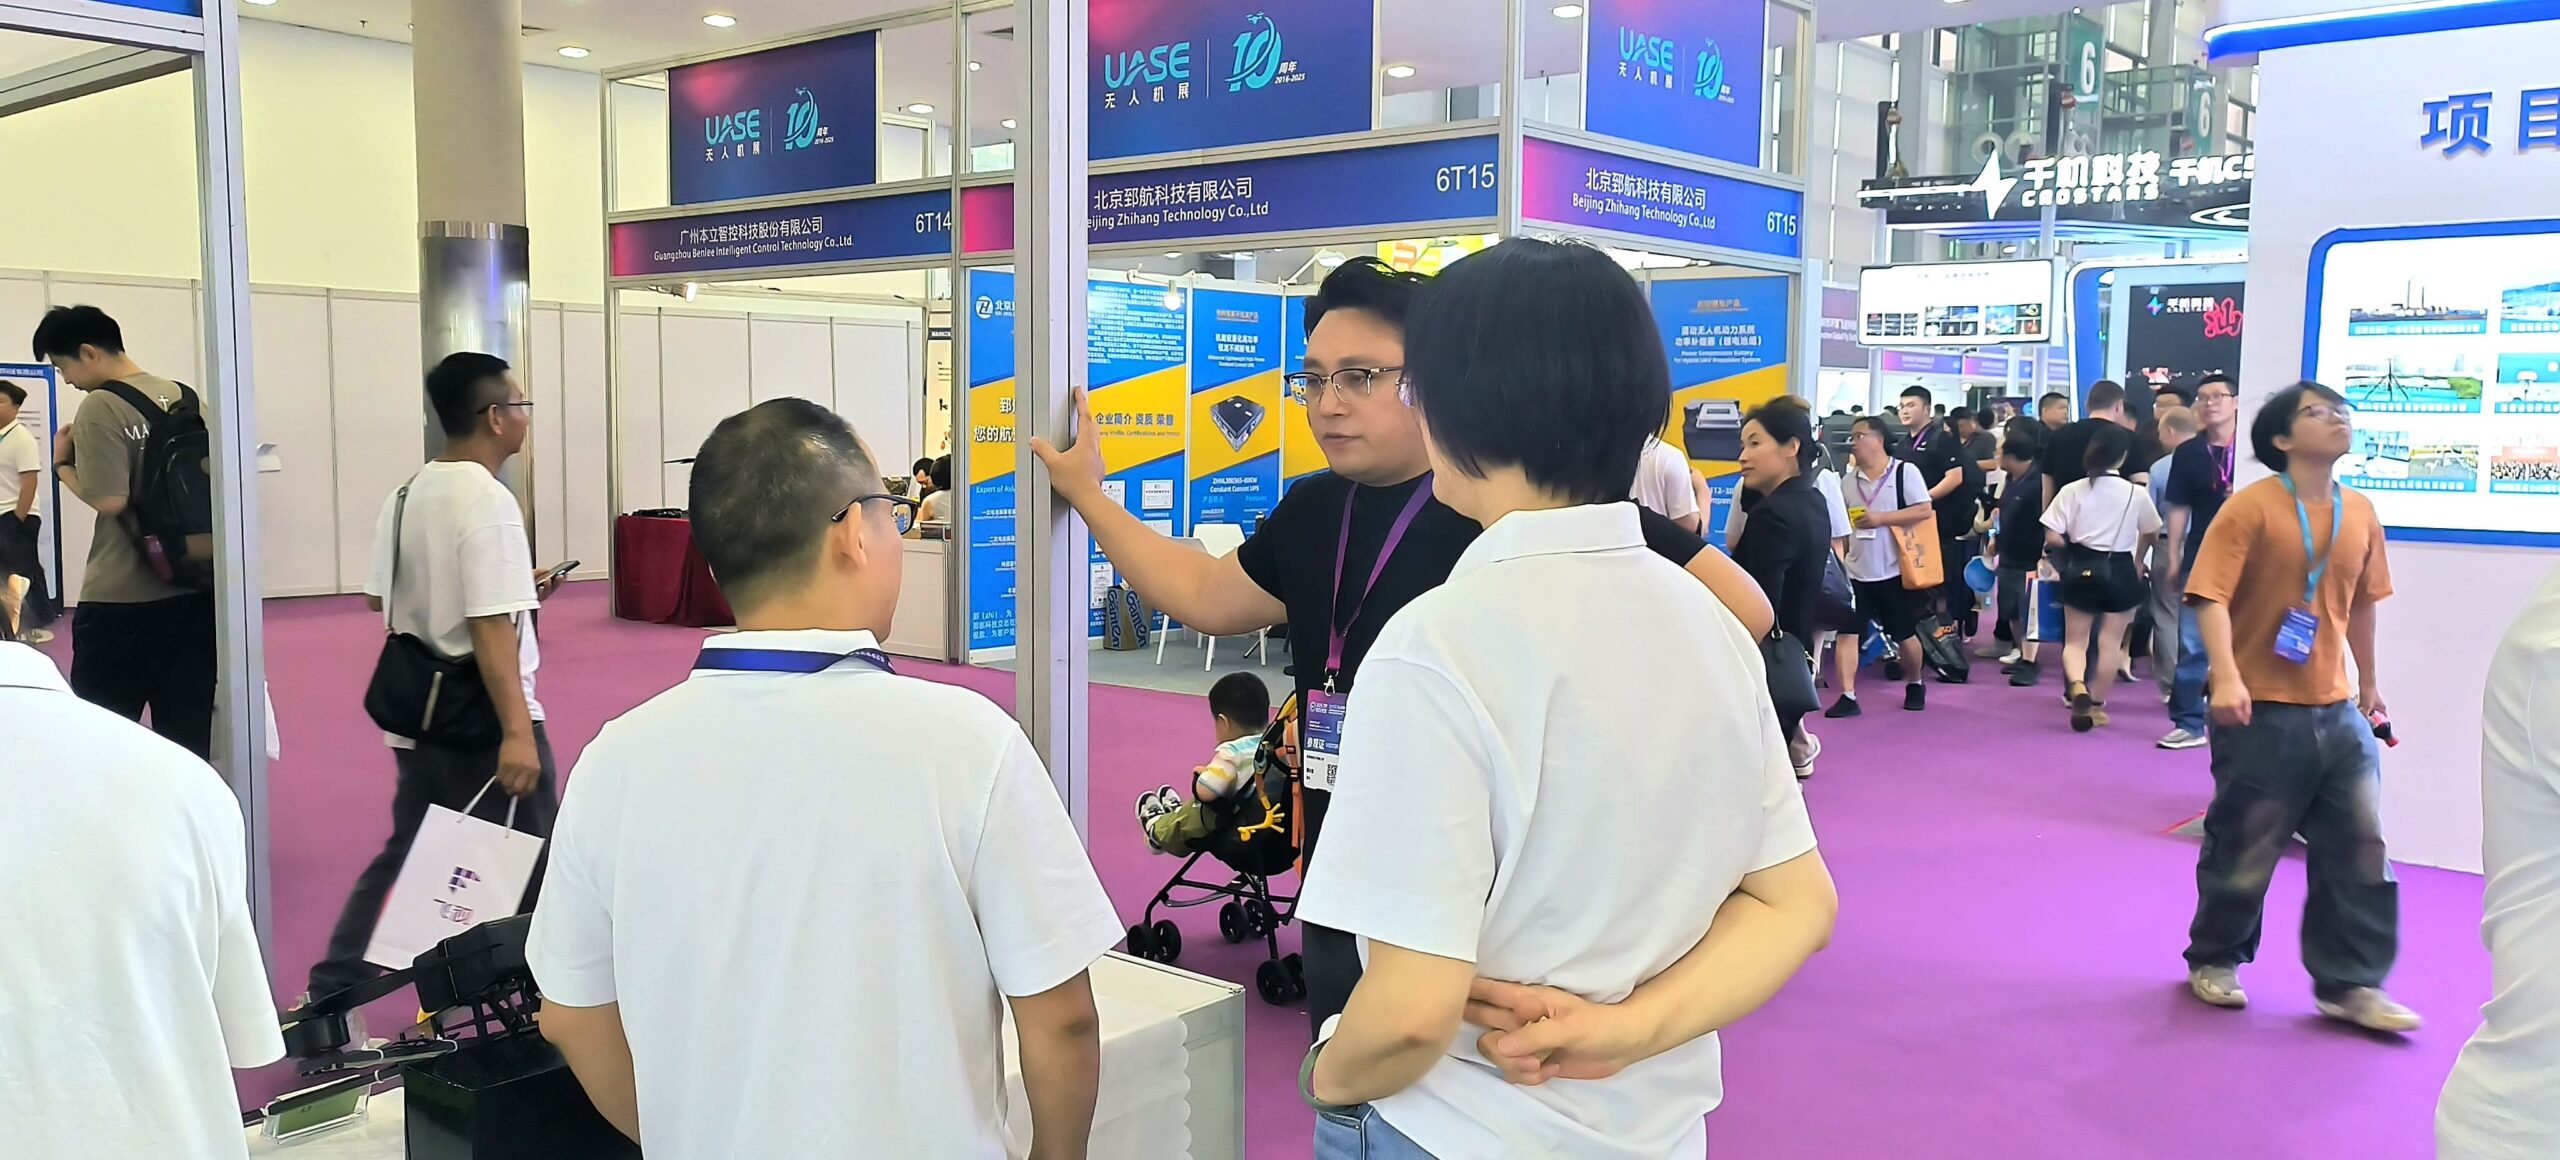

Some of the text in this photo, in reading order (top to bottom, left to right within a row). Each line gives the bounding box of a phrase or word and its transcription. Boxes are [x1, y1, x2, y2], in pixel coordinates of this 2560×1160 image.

[1228, 29, 1282, 93] 10
[1620, 26, 1674, 72] UASE
[1104, 42, 1190, 89] UASE
[1274, 72, 1306, 85] 2016-2025
[1278, 61, 1298, 74] 周年
[1619, 61, 1674, 89] 无人机展
[1694, 50, 1723, 100] 10
[2080, 41, 2096, 94] 6
[1104, 82, 1190, 109] 无人机展
[705, 108, 760, 145] UASE
[784, 100, 819, 150] 10
[2199, 92, 2211, 138] 6
[2420, 87, 2560, 160] 项目
[705, 141, 760, 161] 无人机展
[1436, 163, 1495, 192] 6T15
[1585, 167, 1706, 210] 北京郅航科技有限公司
[1093, 176, 1253, 211] 北京郅航科技有限公司
[2021, 183, 2160, 208] CROSTARS
[915, 210, 952, 233] 6T14
[1087, 201, 1269, 231] eijing Zhihang Technology Co.,Ltd
[1572, 192, 1716, 230] Beijing Zhihang Technology Co.,Ltd
[1766, 211, 1797, 236] 6T15
[679, 216, 823, 246] 广州本立智控科技股份有限公司
[653, 250, 692, 263] Guangzhou
[692, 248, 715, 258] Benlee
[715, 244, 751, 259] Intelligent
[752, 243, 780, 254] Control
[781, 238, 823, 252] Technology
[994, 299, 1015, 311] 北京
[1000, 397, 1015, 413] 郅
[974, 425, 1015, 442] 您的航
[976, 486, 996, 495] Expert
[997, 485, 1004, 493] of
